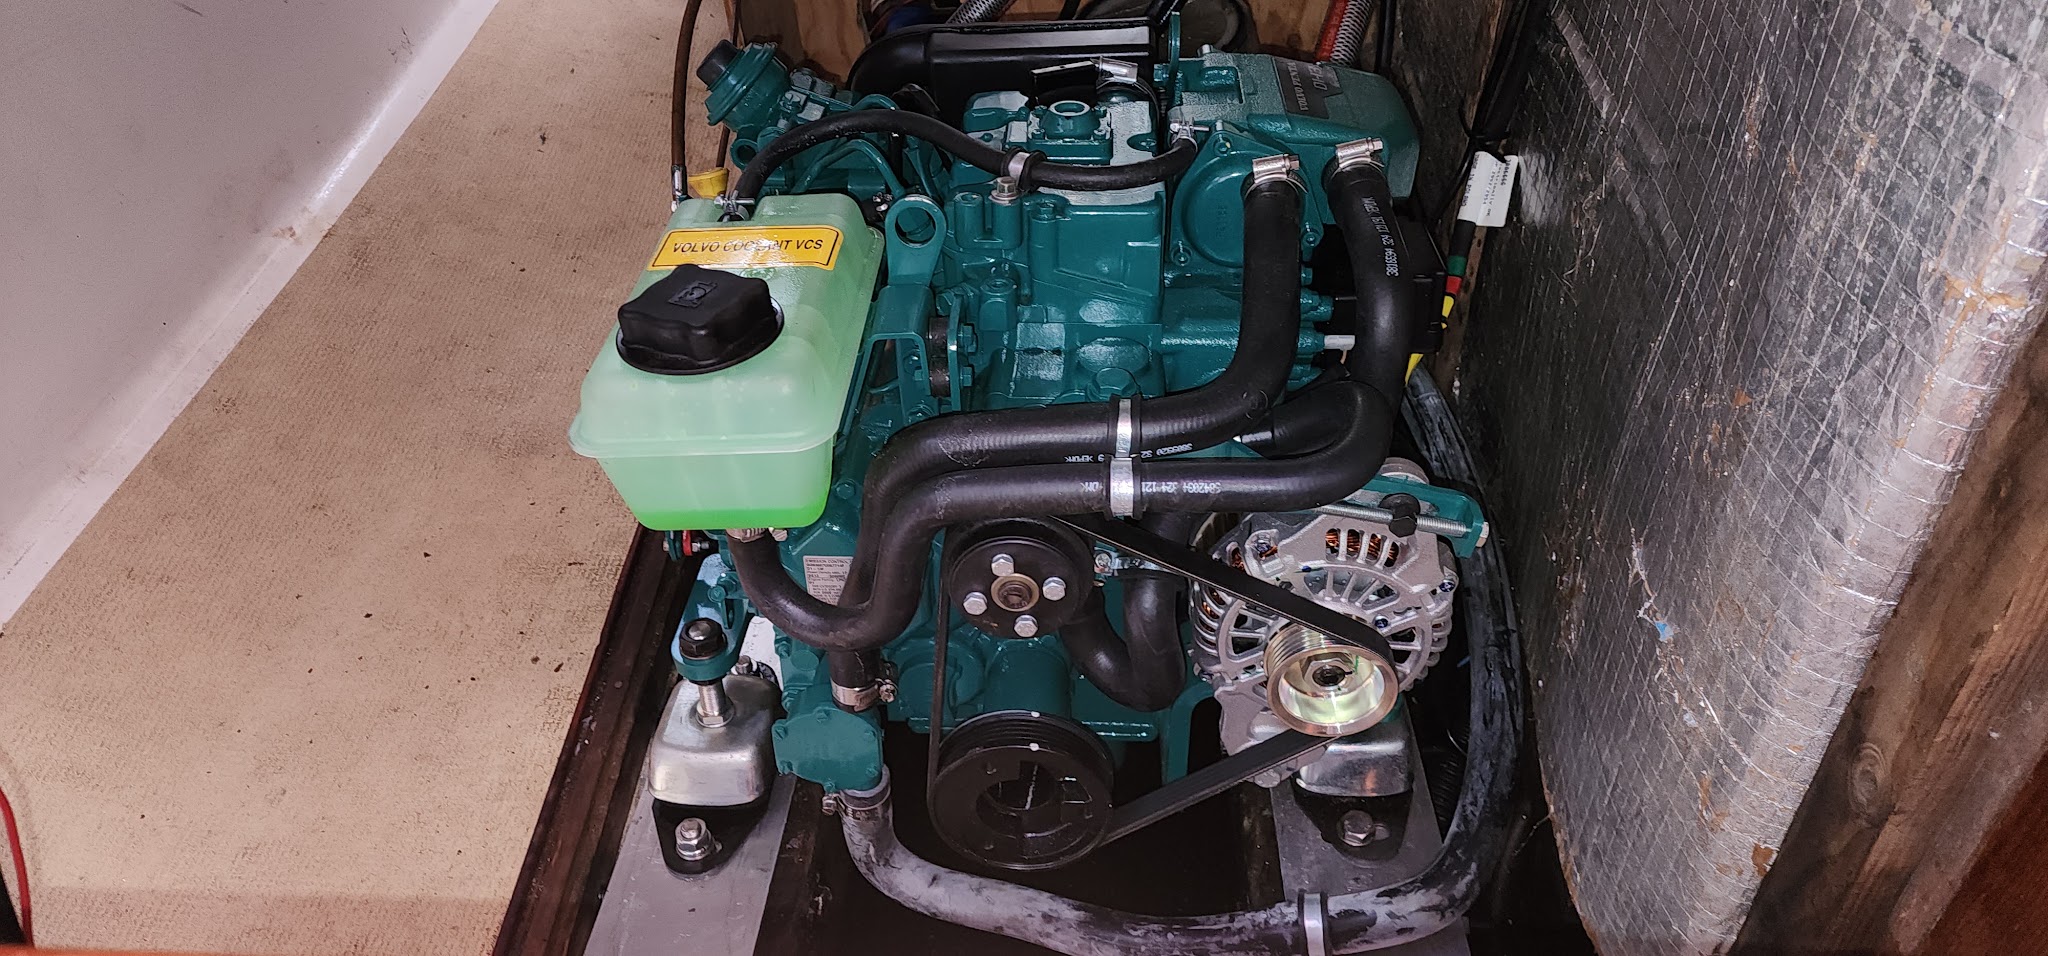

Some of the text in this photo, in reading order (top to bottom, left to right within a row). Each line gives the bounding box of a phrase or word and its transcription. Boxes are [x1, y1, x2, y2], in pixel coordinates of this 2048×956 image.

[1295, 87, 1309, 111] VOLVO
[673, 241, 720, 253] VOLVO
[796, 239, 824, 250] VCS
